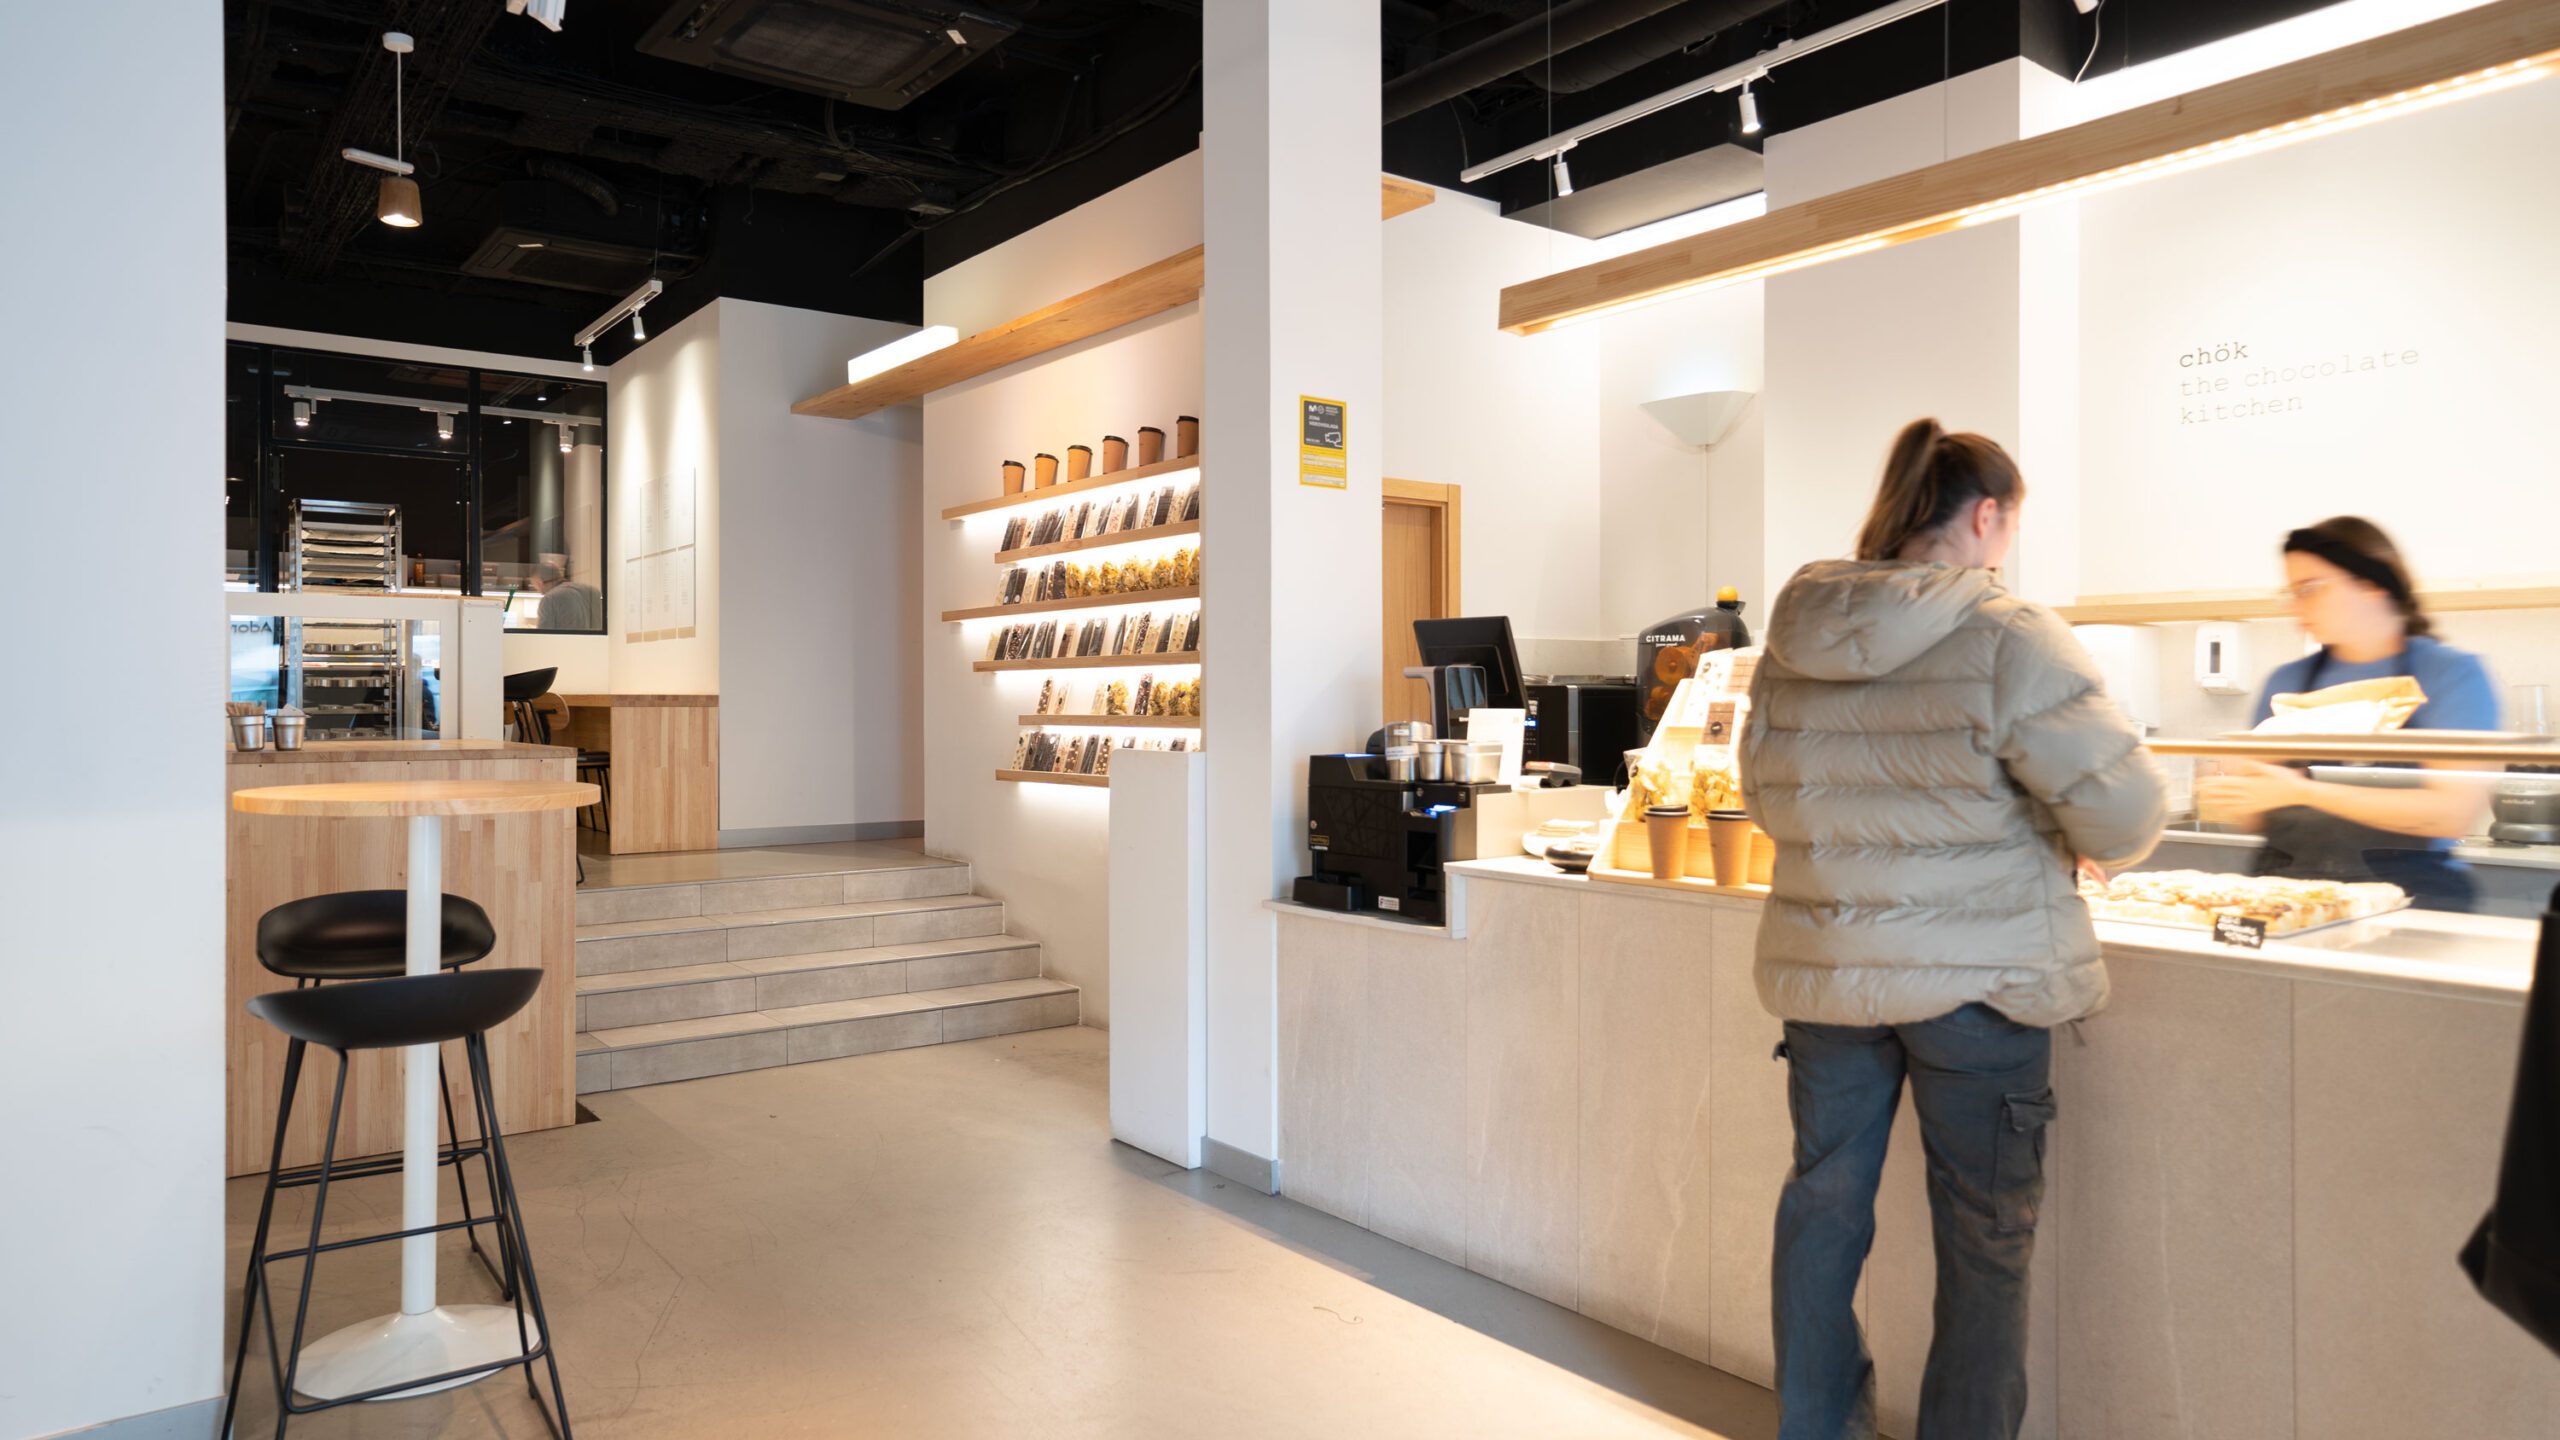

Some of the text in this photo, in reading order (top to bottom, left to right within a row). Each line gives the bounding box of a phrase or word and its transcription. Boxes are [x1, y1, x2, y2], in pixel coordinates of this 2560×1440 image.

[2179, 341, 2249, 368] chök
[2180, 348, 2420, 396] the chocolate
[2180, 396, 2303, 424] kitchen
[1646, 634, 1685, 643] CITRAMA
